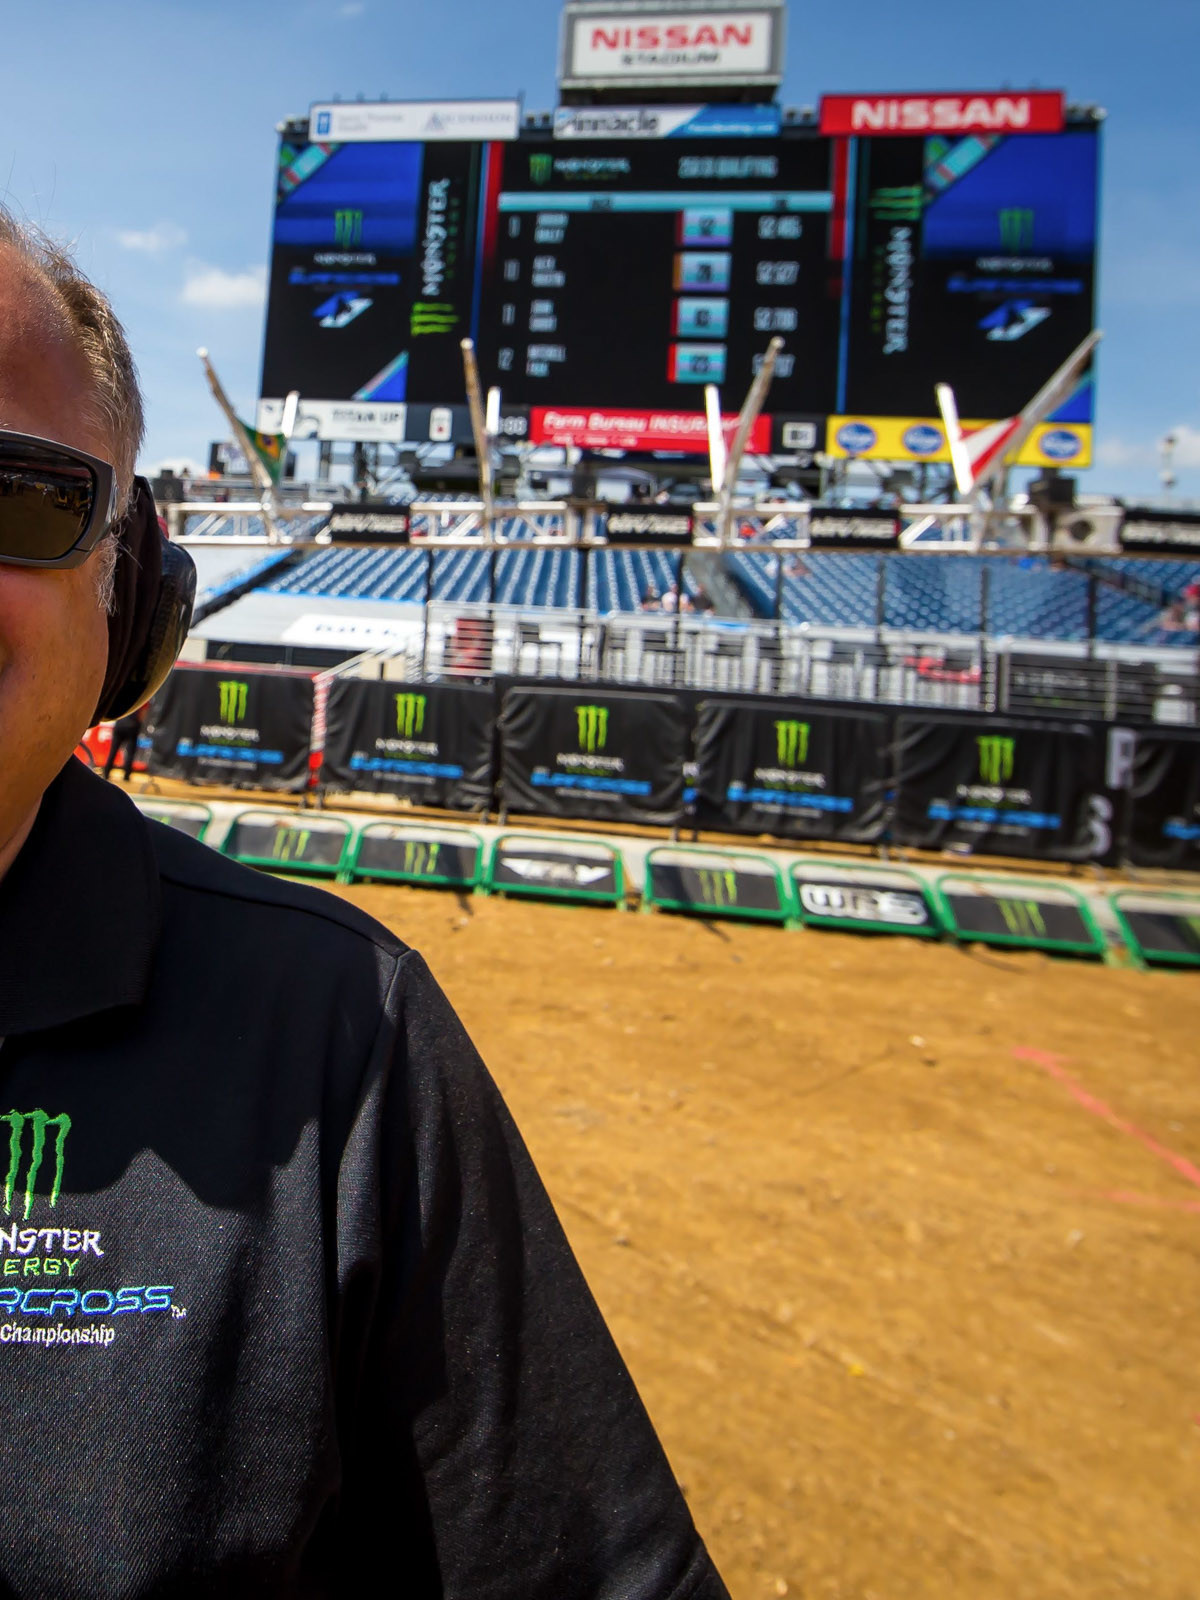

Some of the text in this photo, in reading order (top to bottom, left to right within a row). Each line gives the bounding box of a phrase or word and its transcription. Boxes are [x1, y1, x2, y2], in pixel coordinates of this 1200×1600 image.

[591, 24, 753, 50] NISSAN
[851, 98, 1031, 130] NISSAN
[0, 1322, 115, 1347] Championship
